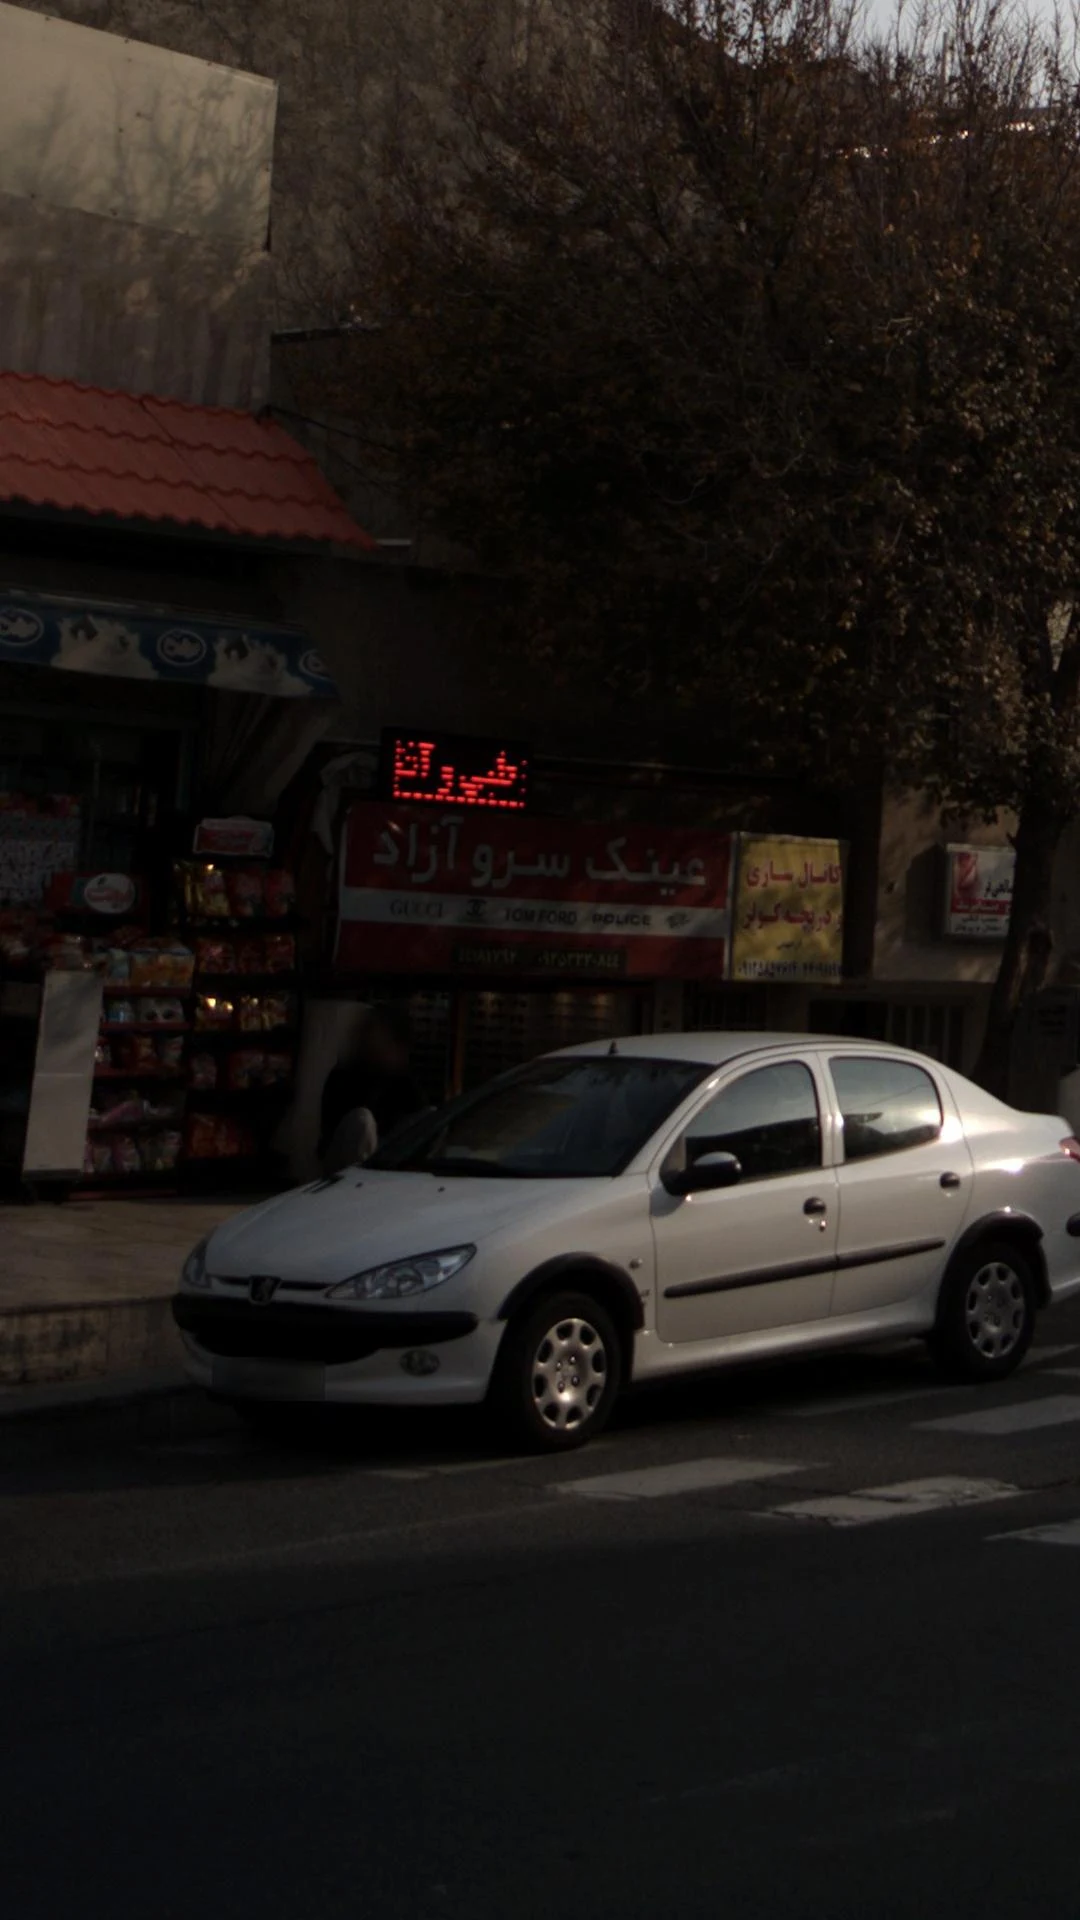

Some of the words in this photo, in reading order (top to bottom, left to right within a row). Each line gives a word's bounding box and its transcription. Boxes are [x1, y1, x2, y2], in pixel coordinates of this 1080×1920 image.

[373, 815, 464, 883] آزاد
[471, 843, 571, 889] سرو
[586, 836, 706, 896] عینک
[798, 860, 842, 889] کانال
[389, 898, 444, 919] GUCCI
[504, 908, 536, 923] TOM
[537, 908, 578, 926] FORD
[591, 912, 652, 927] POLICE
